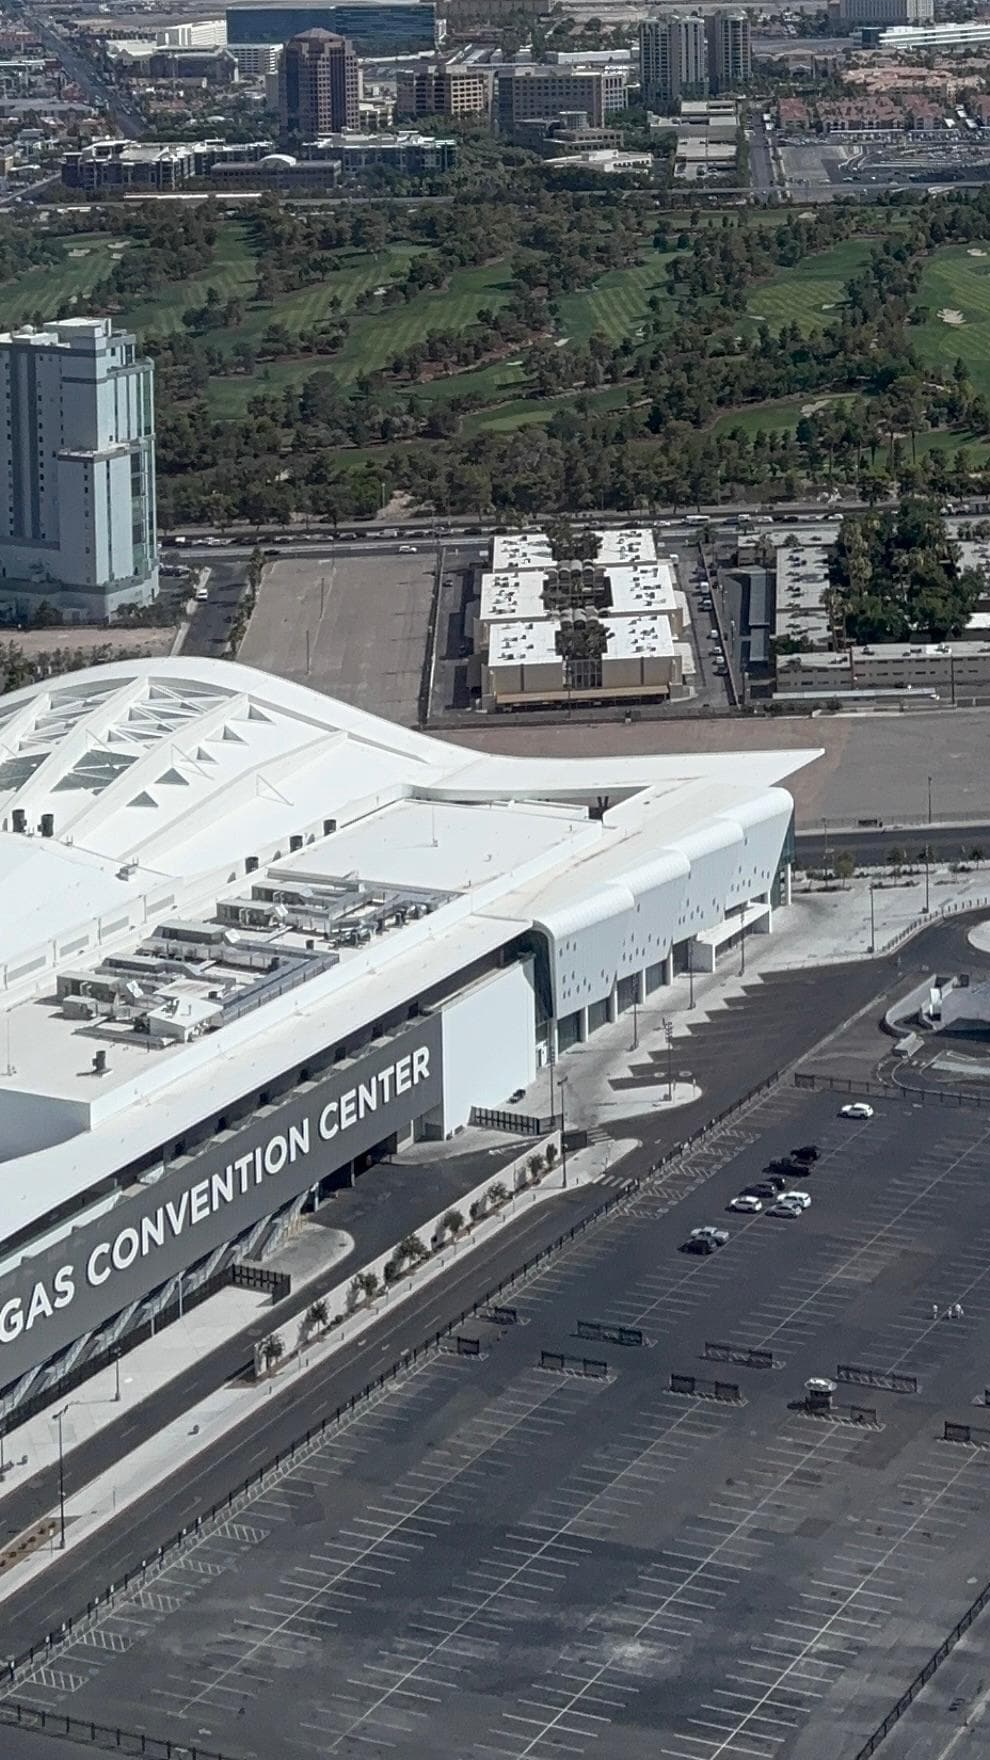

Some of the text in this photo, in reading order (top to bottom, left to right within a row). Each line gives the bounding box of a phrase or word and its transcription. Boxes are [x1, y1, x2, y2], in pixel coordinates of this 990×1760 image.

[0, 1046, 430, 1343] GAS CONVENTION CENTER
